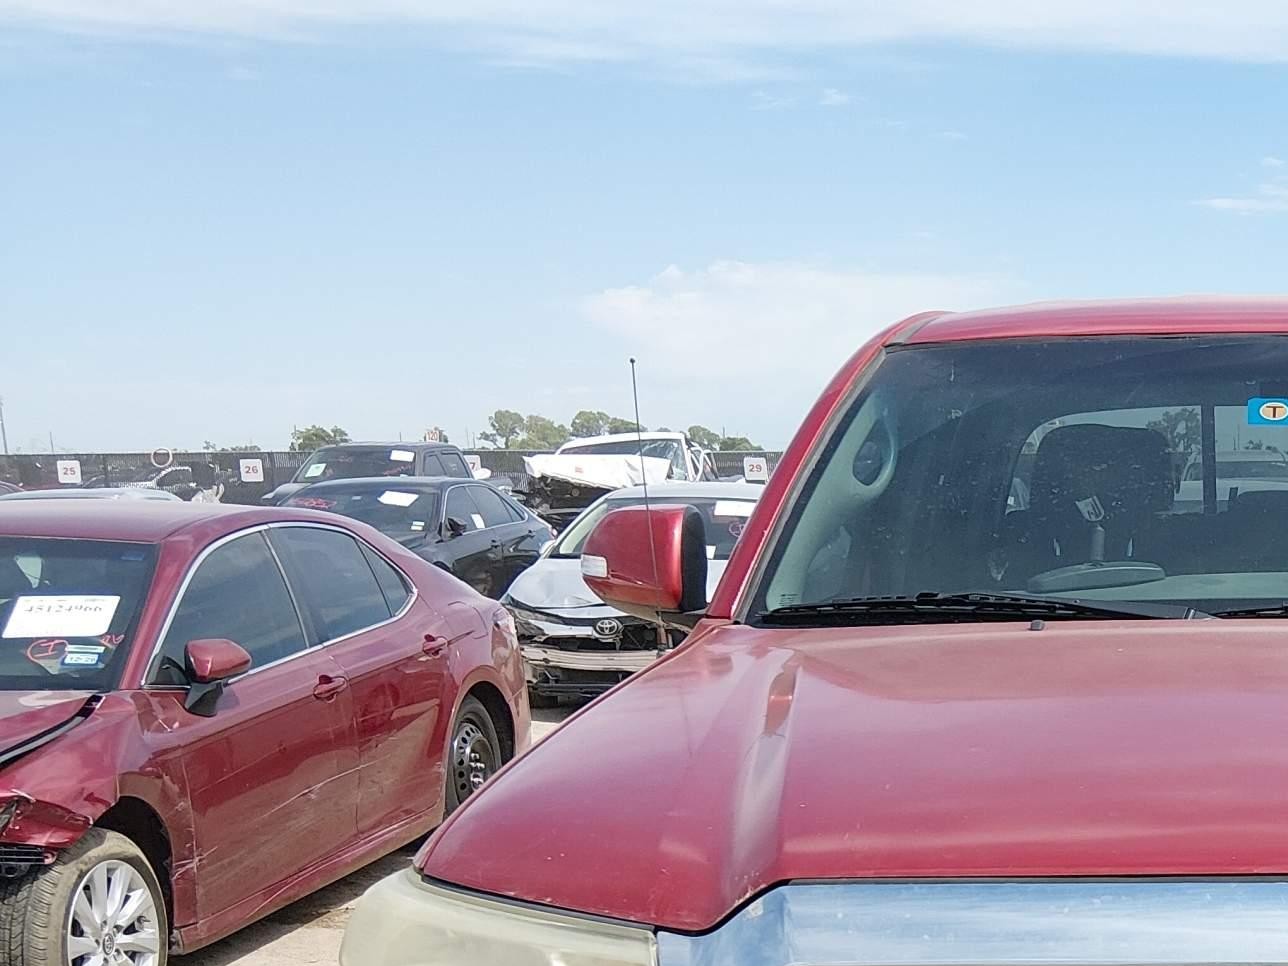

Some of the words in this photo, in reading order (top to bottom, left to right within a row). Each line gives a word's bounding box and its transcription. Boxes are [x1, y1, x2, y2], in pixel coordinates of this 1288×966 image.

[1266, 405, 1284, 418] T
[427, 431, 438, 441] 120
[62, 466, 76, 476] 25
[244, 465, 258, 475] 26
[748, 464, 762, 472] 29
